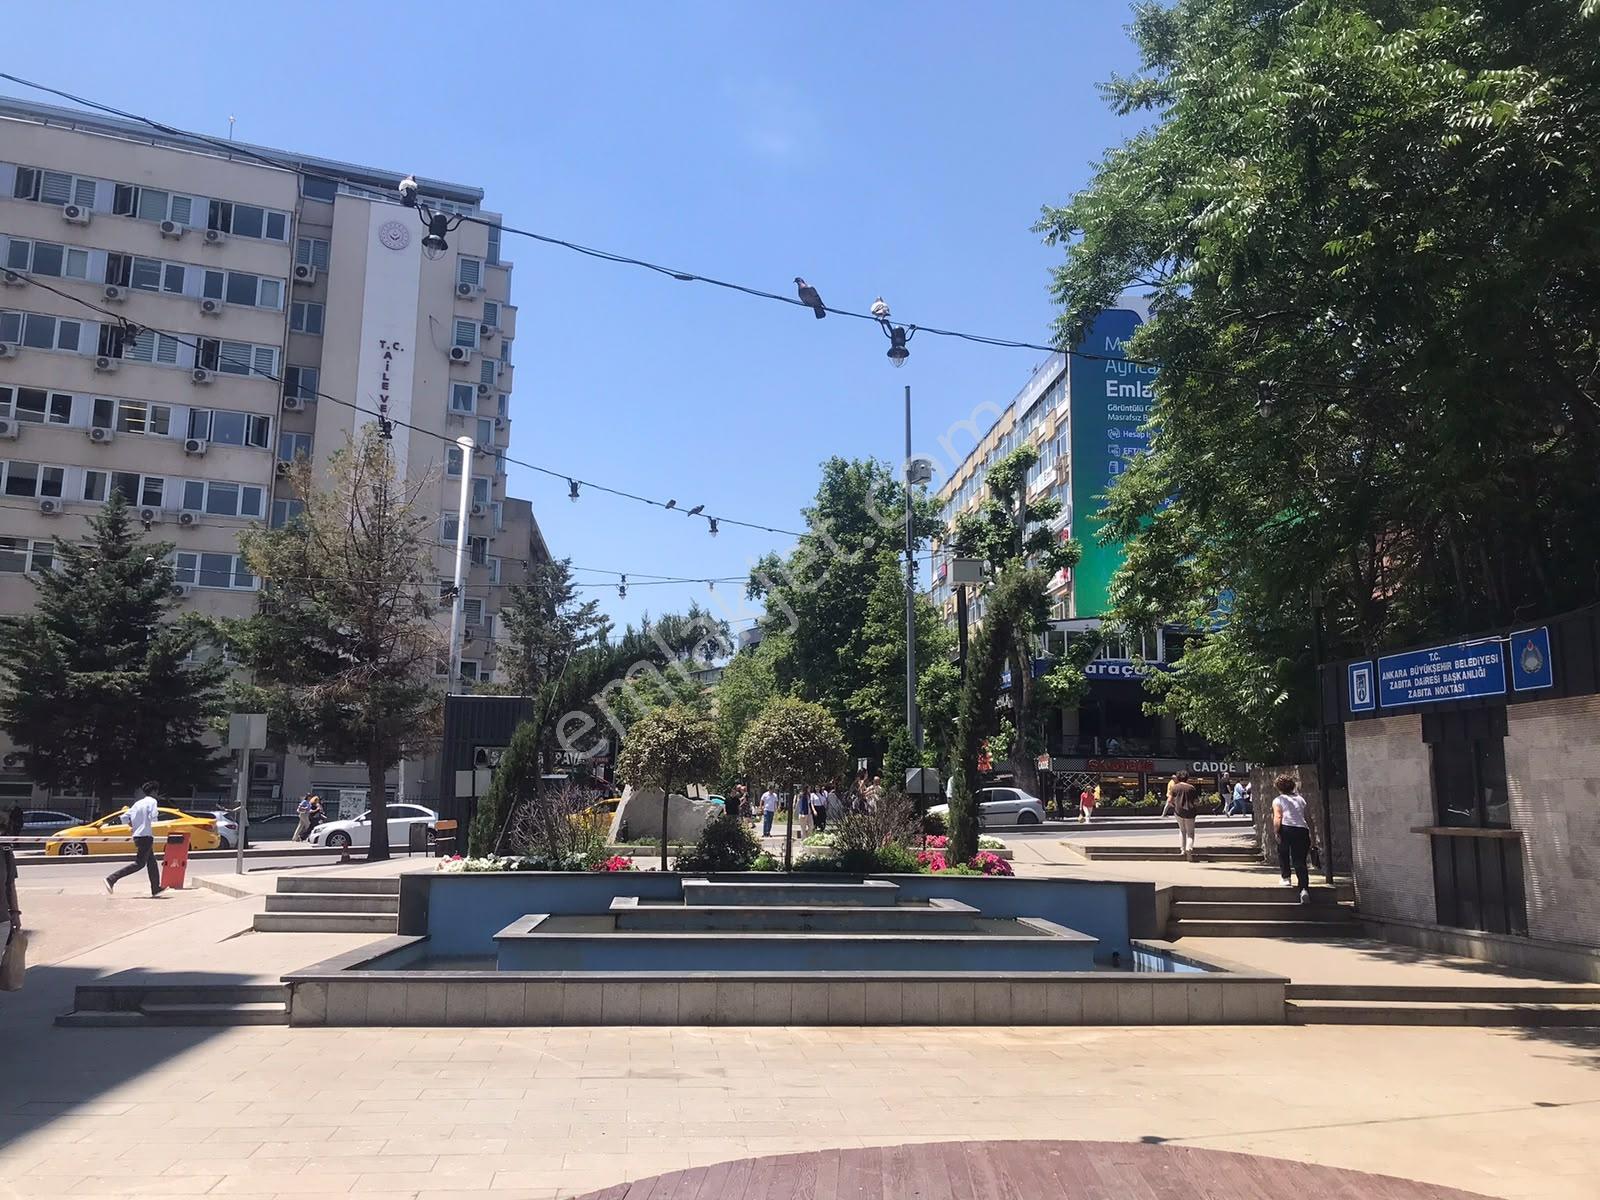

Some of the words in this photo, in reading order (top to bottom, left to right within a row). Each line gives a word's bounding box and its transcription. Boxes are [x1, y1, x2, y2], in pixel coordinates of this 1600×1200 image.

[379, 340, 404, 353] T.C.
[1106, 379, 1159, 398] Emla
[1107, 403, 1144, 412] Görüntülü
[1428, 652, 1441, 661] T.C.
[1382, 669, 1408, 681] ANKARA
[1455, 653, 1499, 669] BELEDİYESİ
[1389, 678, 1412, 690] ZABITA
[1414, 675, 1441, 687] DAİRESİ
[1443, 666, 1486, 684] BAŞKANLIĞI
[1408, 687, 1433, 699] ZABITA
[1434, 682, 1465, 695] NOKTASI
[1192, 761, 1236, 773] CADDE
